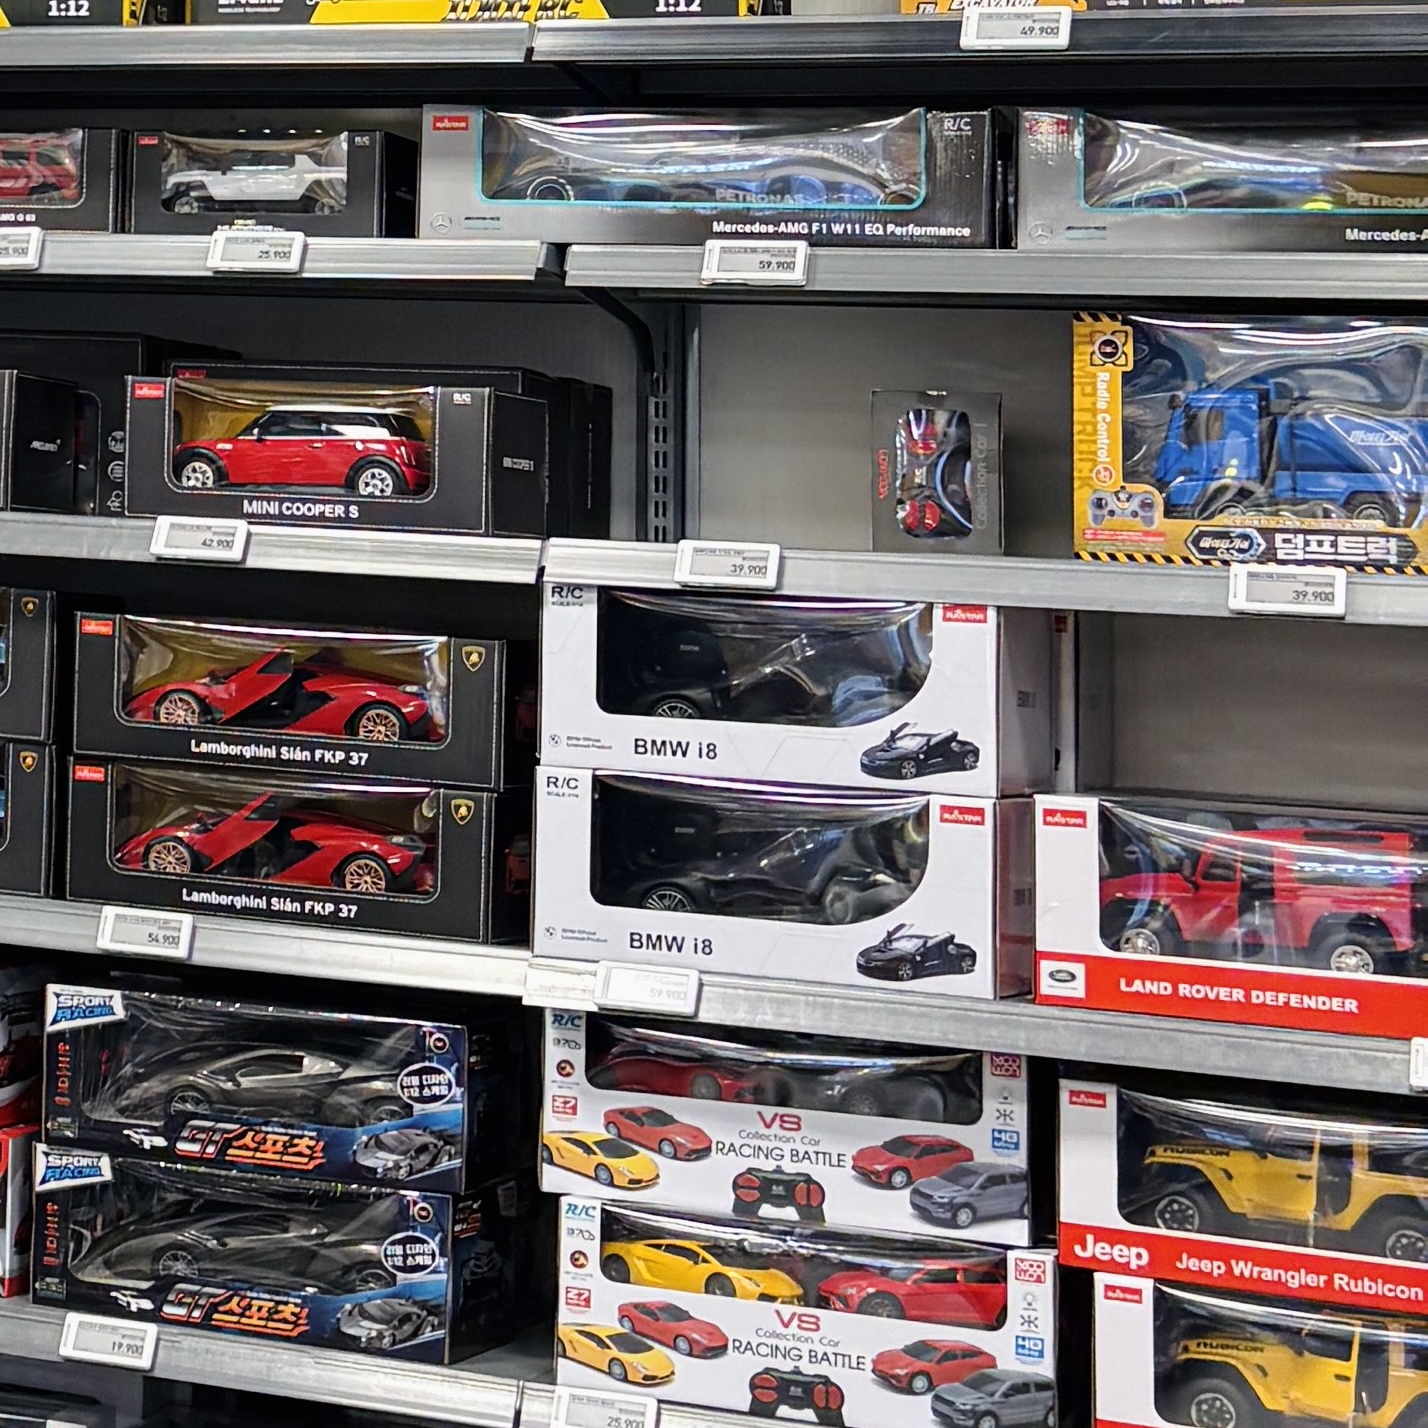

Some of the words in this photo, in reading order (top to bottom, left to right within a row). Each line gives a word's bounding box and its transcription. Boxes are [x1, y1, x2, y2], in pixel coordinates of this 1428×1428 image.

[47, 0, 91, 17] 1:12
[712, 220, 809, 235] Mercedes-AMG
[812, 222, 827, 234] F1
[831, 222, 860, 235] W11
[864, 224, 885, 236] EQ
[886, 224, 971, 237] Performance
[1096, 372, 1111, 409] Radio
[1096, 413, 1111, 462] Control
[243, 499, 279, 515] MINI
[281, 501, 345, 518] COOPER
[347, 503, 359, 519] S
[1274, 533, 1398, 564] 덤프트럭
[730, 564, 767, 576] 39.900
[549, 584, 584, 602] R/C
[1292, 589, 1335, 603] 39.900
[190, 739, 277, 764] Lamborghini
[280, 745, 311, 763] Sián
[314, 748, 346, 765] FKP
[349, 751, 369, 766] 37
[633, 737, 690, 760] BMW
[696, 739, 718, 760] i8
[545, 776, 580, 793] R/C
[181, 887, 268, 913] Lamborghini
[270, 894, 301, 913] Sián
[304, 898, 336, 916] FKP
[338, 902, 358, 919] 37
[628, 931, 685, 954] BMW
[691, 935, 714, 955] i8
[57, 994, 112, 1008] SPORT
[1119, 977, 1173, 997] LAND
[1177, 981, 1247, 1003] ROVER
[1250, 990, 1359, 1015] DEFENDER
[757, 1111, 802, 1132] VS
[45, 1154, 100, 1168] SPORT
[715, 1140, 785, 1165] RACING
[789, 1147, 847, 1169] BATTLE
[1073, 1233, 1150, 1270] Jeep
[1176, 1252, 1226, 1277] Jeep
[1230, 1259, 1327, 1290] Wrangler
[1333, 1273, 1424, 1302] Rubicon
[774, 1309, 821, 1333] VS
[731, 1338, 803, 1363] RACING
[808, 1347, 866, 1372] BATTLE
